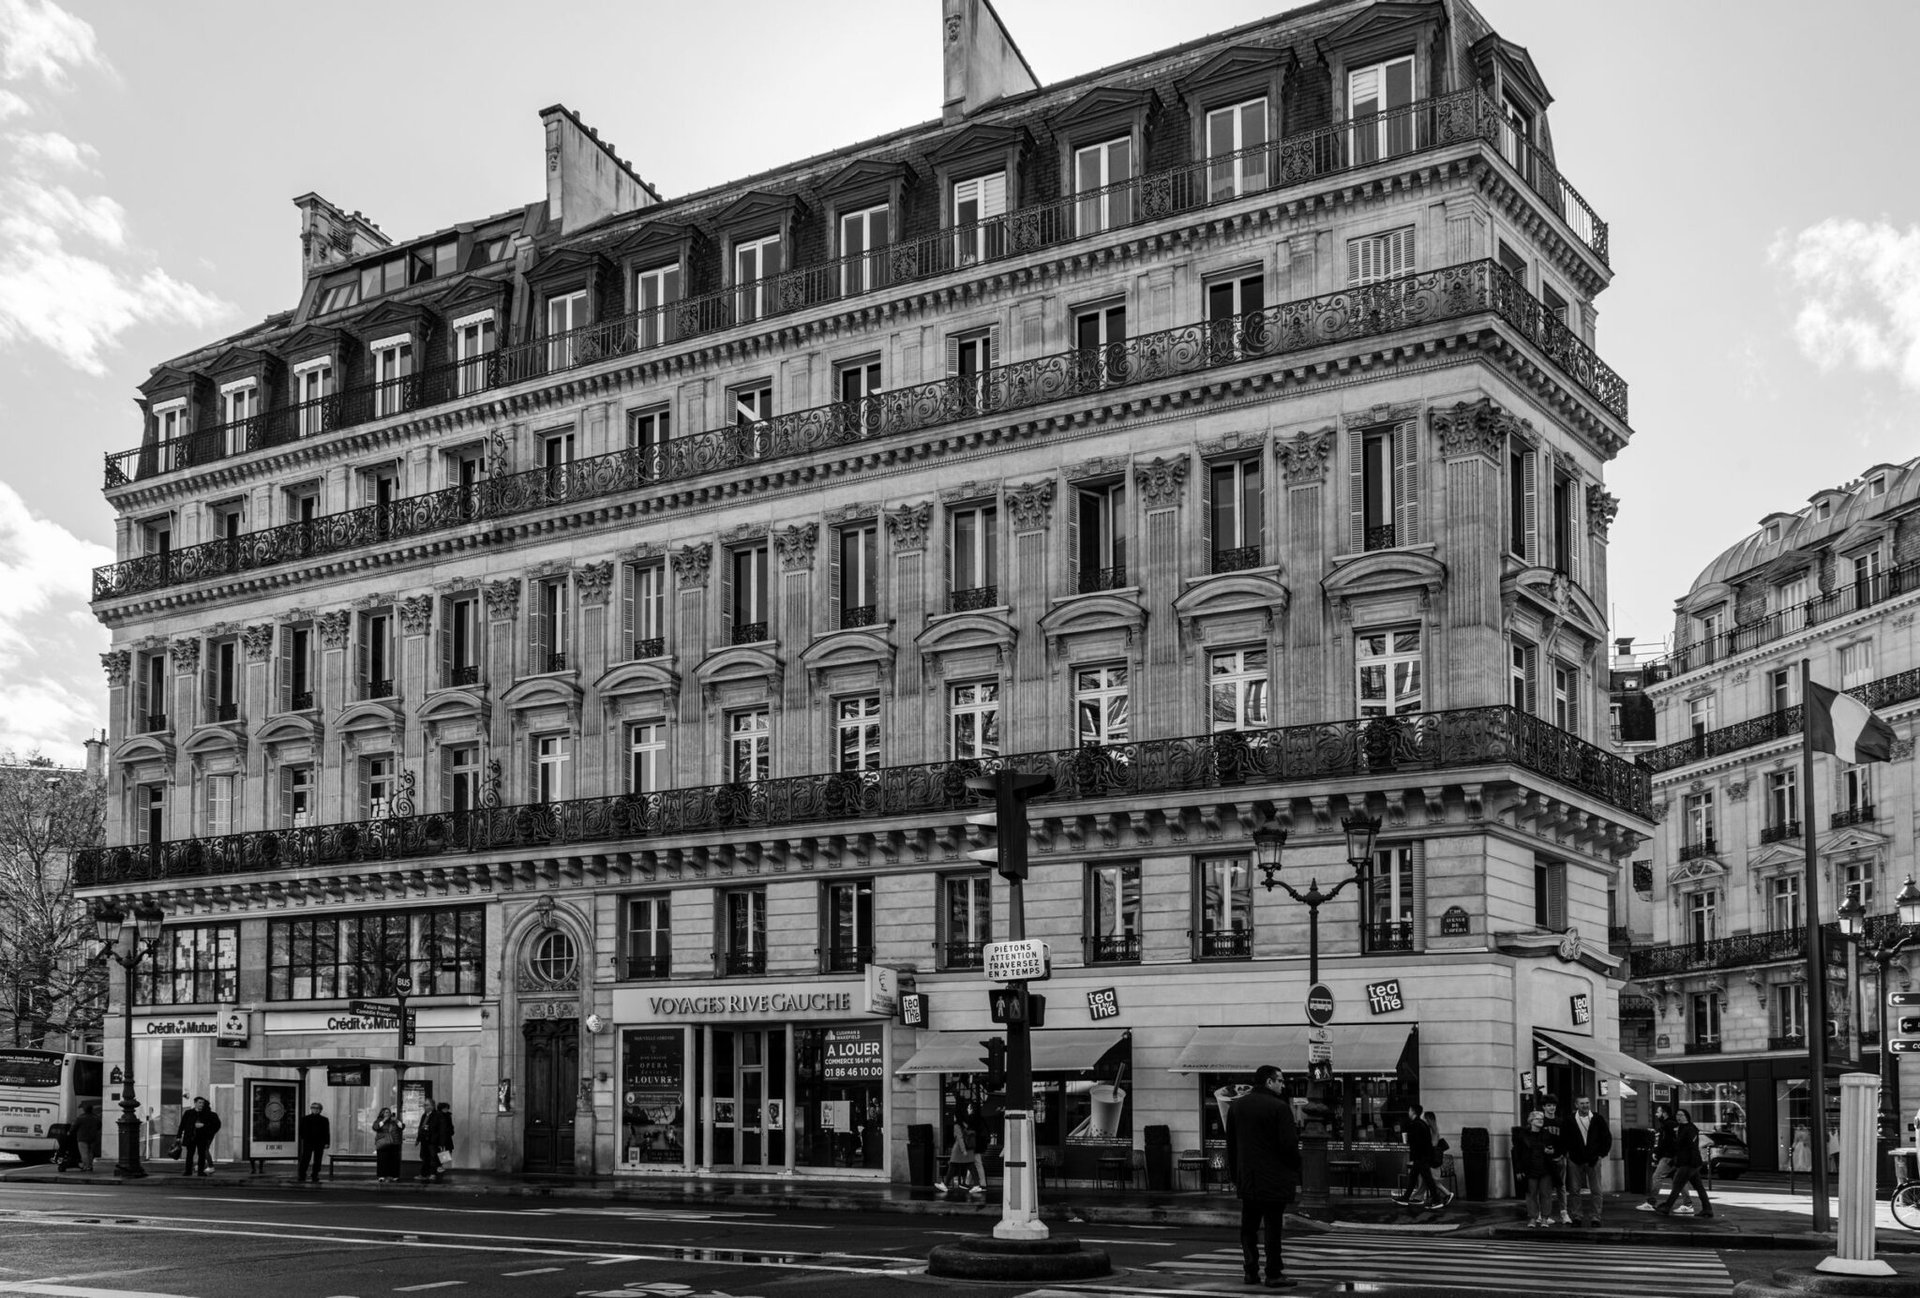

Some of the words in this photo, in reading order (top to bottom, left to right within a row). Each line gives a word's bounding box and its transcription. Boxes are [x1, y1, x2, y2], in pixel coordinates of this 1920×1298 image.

[994, 943, 1032, 953] PIÉTONS
[990, 951, 1037, 962] ATTENTION
[988, 959, 1040, 970] TRAVERSEZ
[988, 970, 1000, 978] EN
[1002, 969, 1008, 977] 2
[1011, 967, 1040, 976] TEMPS
[397, 977, 410, 987] BUS
[1368, 982, 1399, 998] tea
[649, 997, 726, 1015] VOYAGES
[728, 995, 770, 1013] RIVE
[771, 993, 851, 1012] GAUCHE
[1089, 991, 1114, 1005] tea
[146, 1022, 177, 1034] Crédit
[186, 1020, 217, 1033] Mutue
[327, 1016, 361, 1031] Crédit
[827, 1044, 836, 1056] A
[839, 1042, 880, 1056] LOUER
[824, 1068, 834, 1077] 01
[835, 1067, 846, 1077] 86
[847, 1067, 858, 1077] 46
[859, 1066, 869, 1076] 10
[871, 1066, 883, 1076] 00
